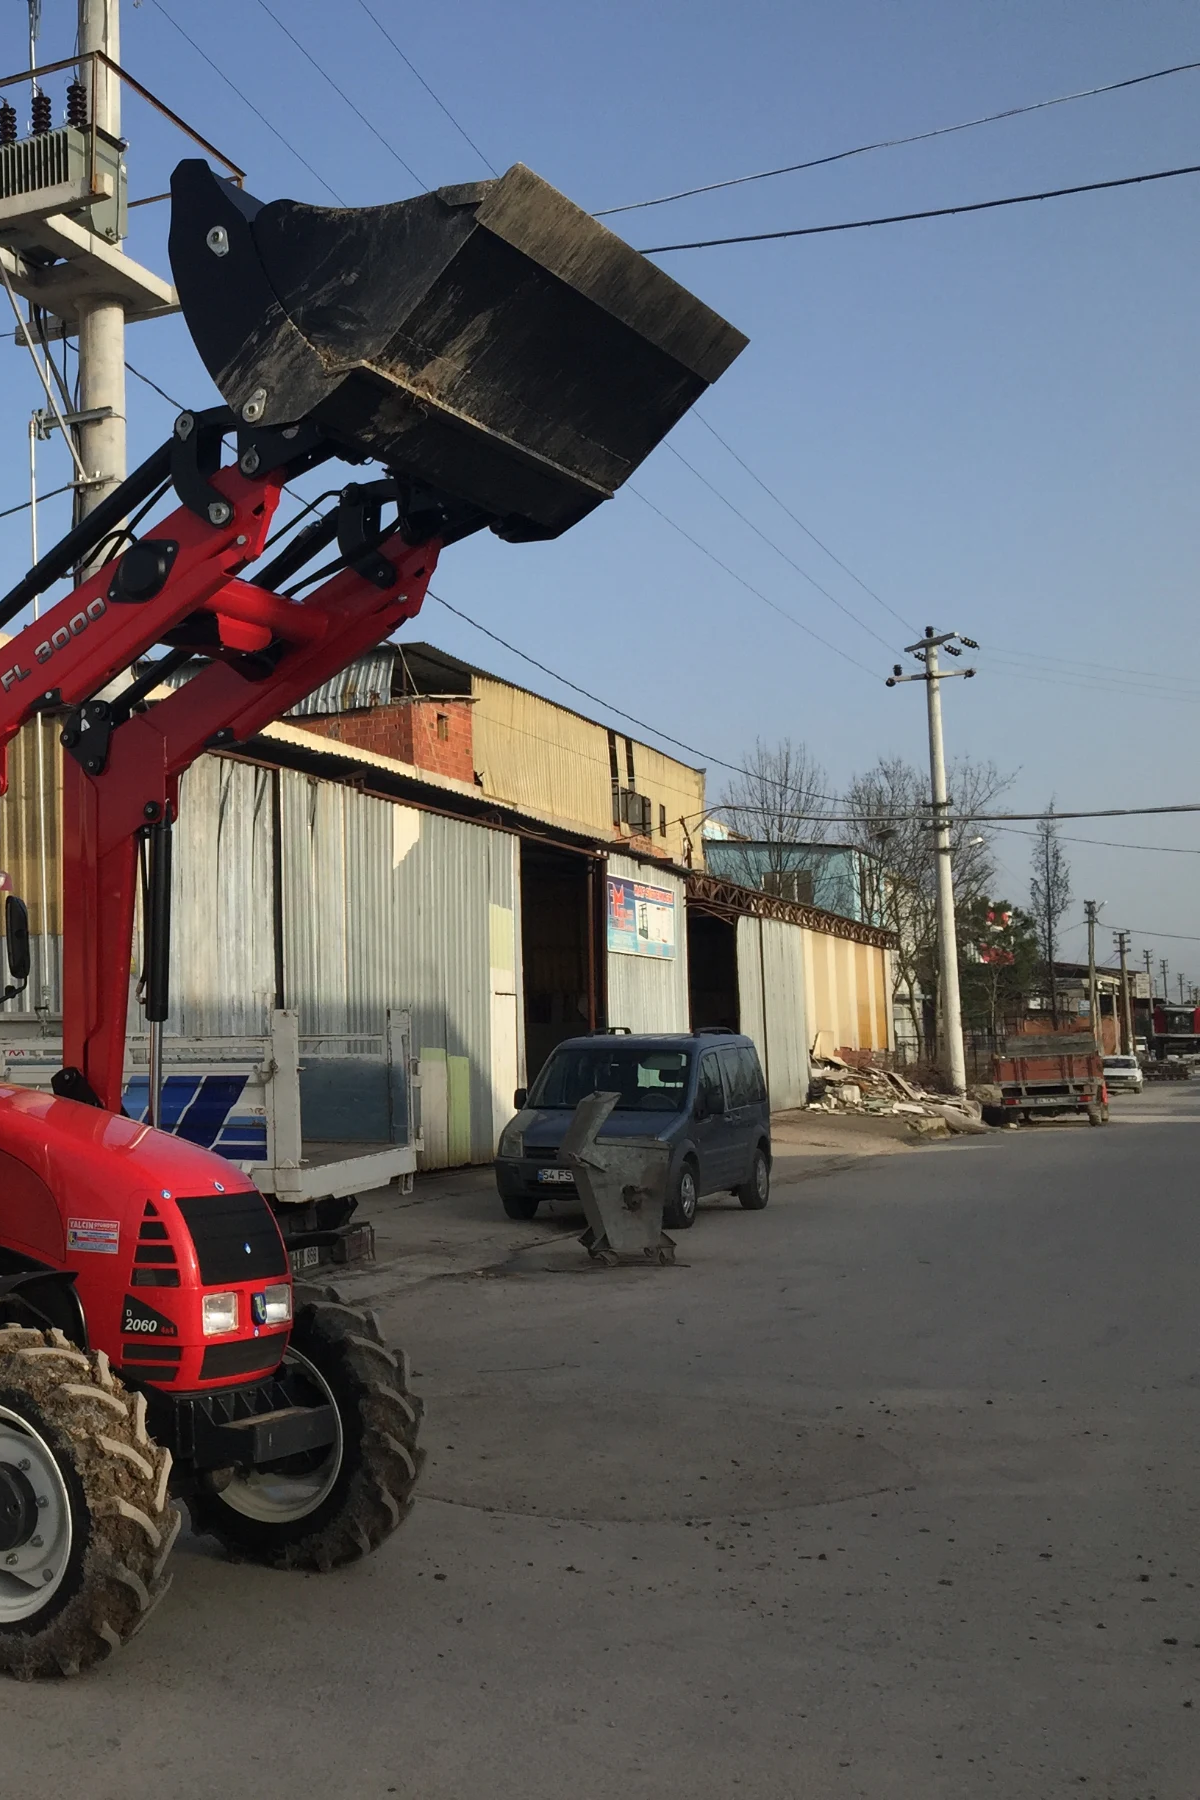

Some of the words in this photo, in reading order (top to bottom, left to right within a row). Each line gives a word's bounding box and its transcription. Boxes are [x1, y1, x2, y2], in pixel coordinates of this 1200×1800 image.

[0, 664, 31, 692] FL
[34, 597, 107, 665] 3000
[543, 1170, 554, 1180] 54
[126, 1309, 132, 1317] D
[125, 1318, 157, 1332] 2060
